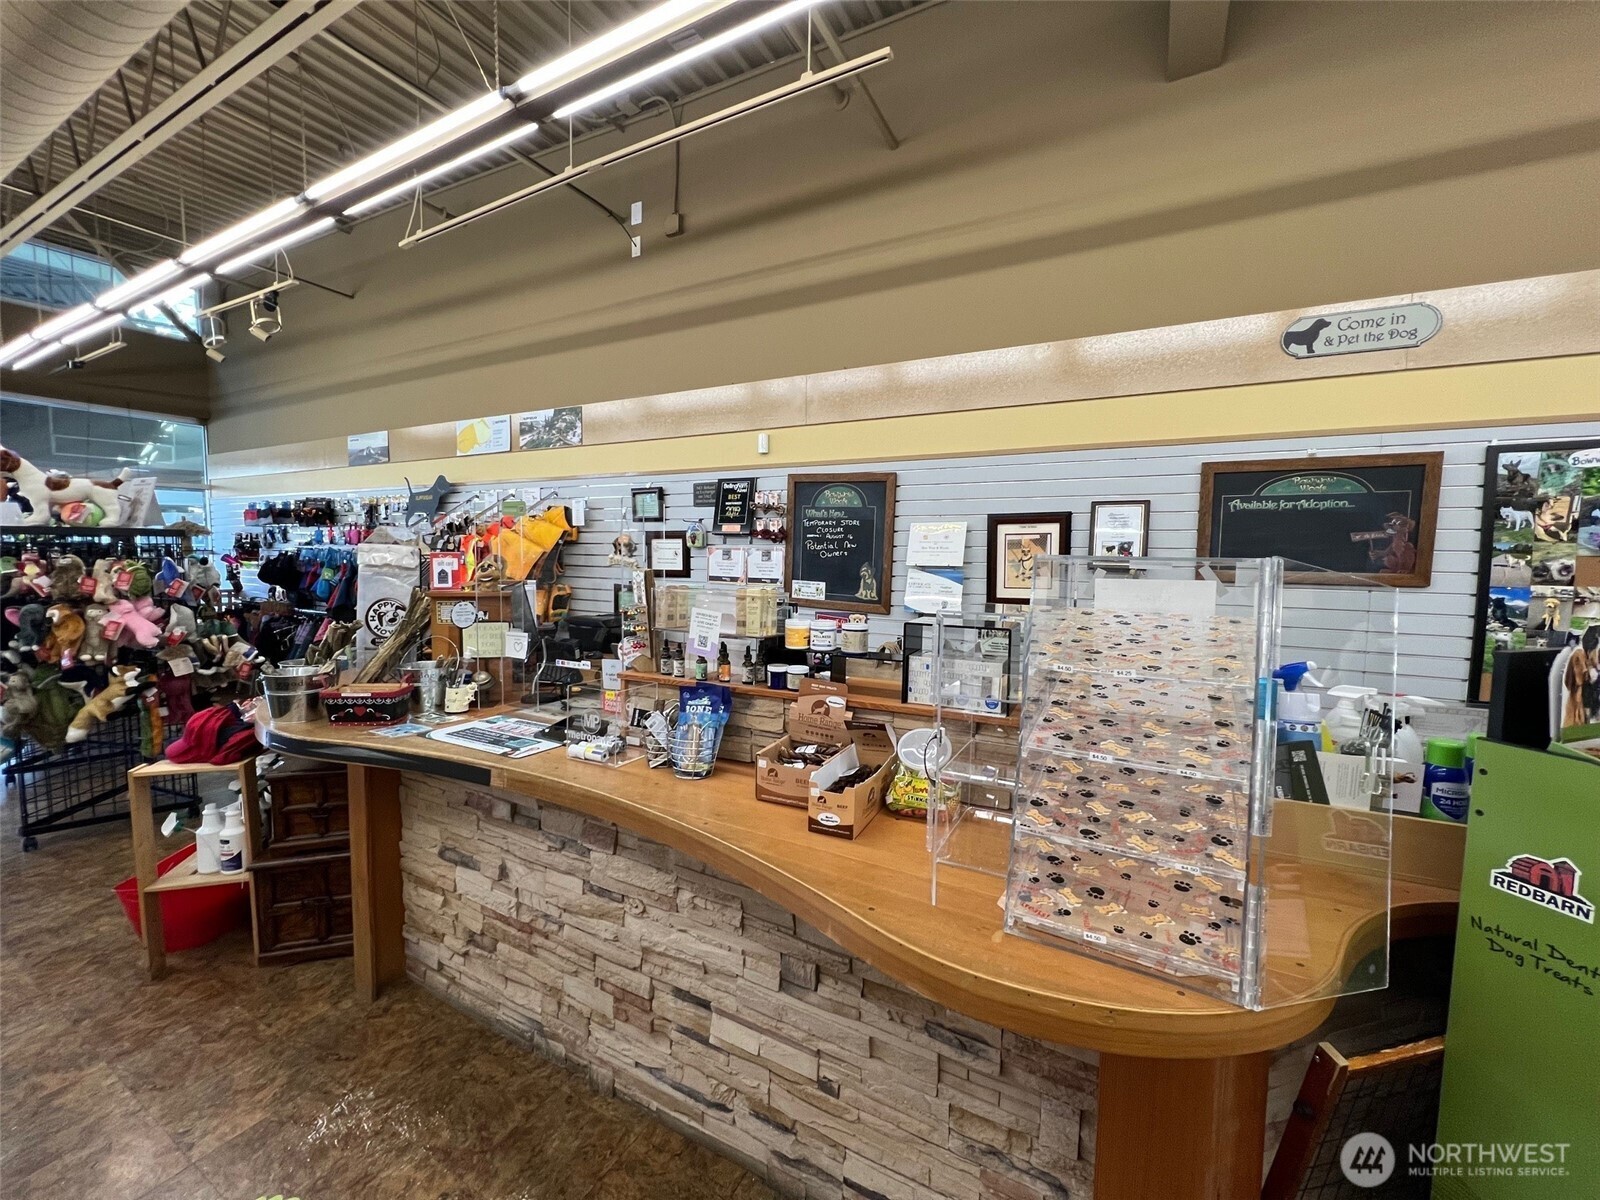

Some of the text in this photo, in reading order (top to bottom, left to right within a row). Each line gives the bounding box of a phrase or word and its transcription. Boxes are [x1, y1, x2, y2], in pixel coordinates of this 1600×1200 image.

[1337, 312, 1406, 331] Come in
[1324, 327, 1418, 347] & Pet the Dog
[1228, 499, 1279, 512] Available
[1279, 500, 1296, 511] for
[840, 519, 860, 527] STORE
[804, 540, 857, 550] Potential New
[819, 550, 848, 559] Owners
[369, 601, 396, 622] HAPPY
[798, 712, 819, 723] Home
[819, 716, 842, 730] Range
[1181, 864, 1199, 873] $4.50
[1493, 875, 1591, 920] REDBARN
[1085, 932, 1102, 942] $4.50
[1470, 915, 1538, 951] Natural
[1485, 937, 1594, 996] Dog Treats
